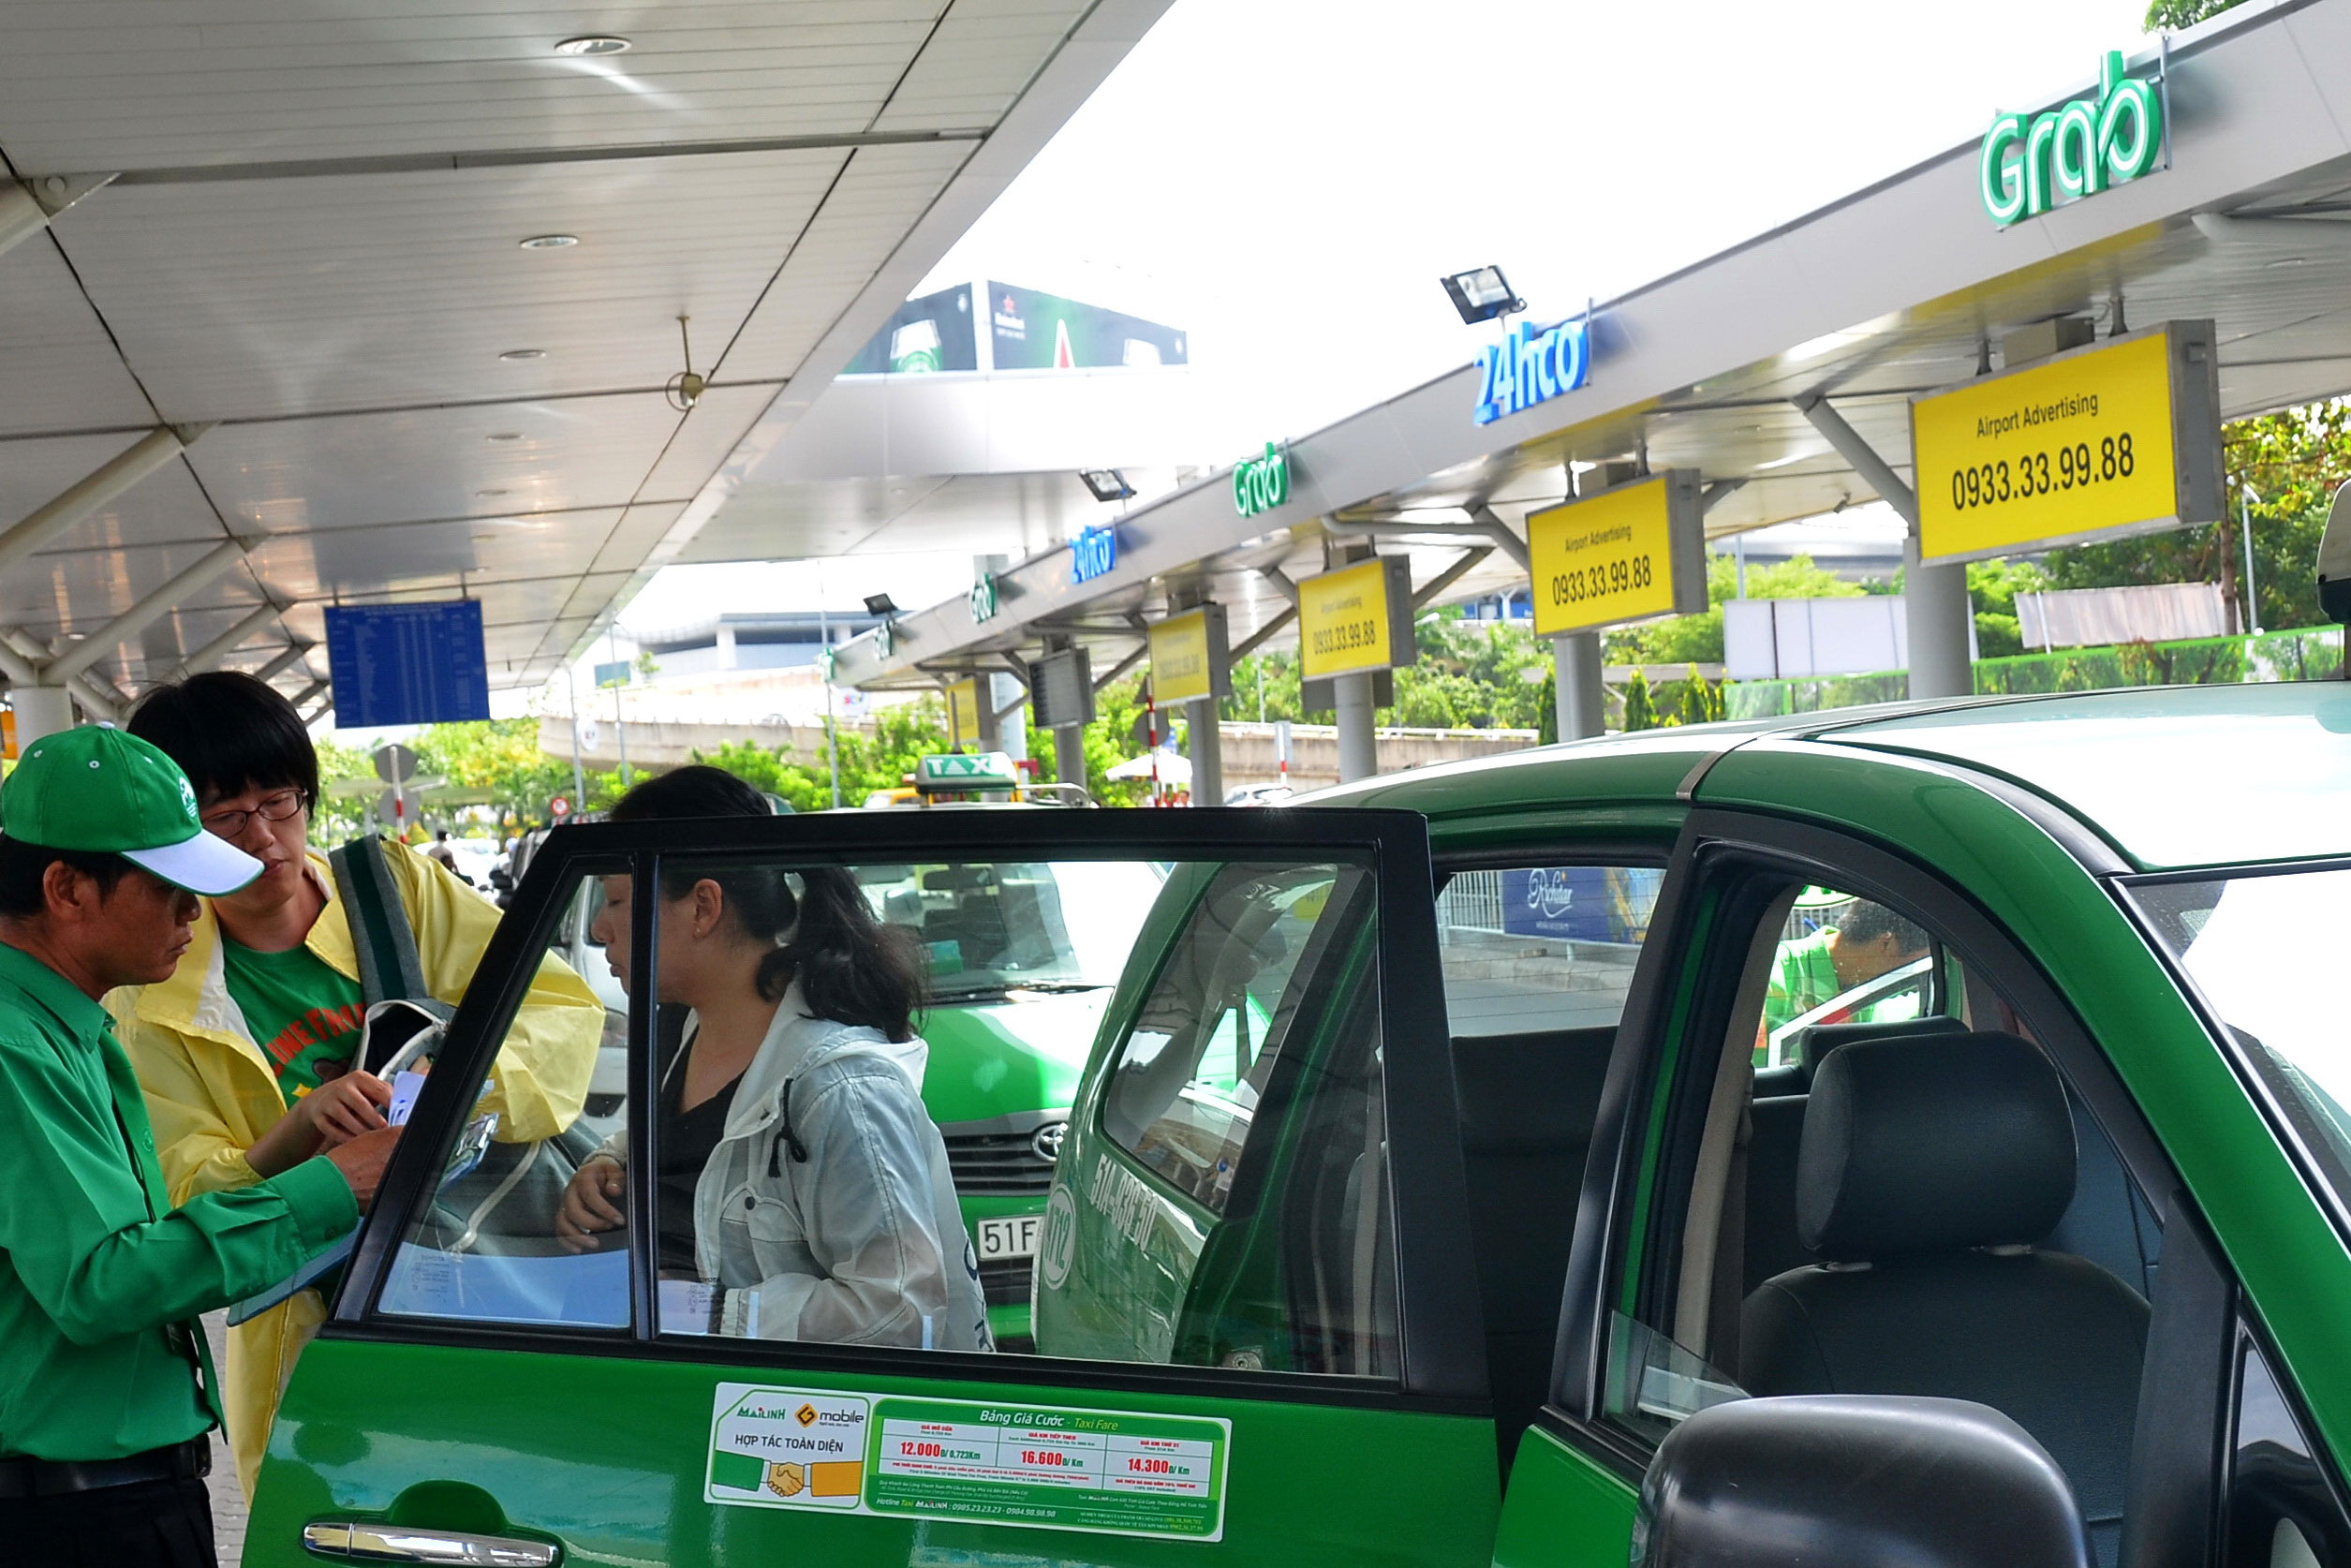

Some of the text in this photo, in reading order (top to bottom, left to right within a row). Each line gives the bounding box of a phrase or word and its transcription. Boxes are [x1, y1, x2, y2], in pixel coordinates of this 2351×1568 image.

[1979, 51, 2161, 225] Grab
[1976, 393, 2099, 438] Airport Advertising
[1233, 441, 1287, 518] Grab
[1952, 432, 2134, 510] 0933.33.99.88
[1552, 555, 1651, 606] 0933.33.99.88
[926, 757, 998, 776] TAX
[734, 1434, 844, 1454] HỢP TÁC TOÀN DIỆN
[980, 1410, 1011, 1425] Bảng
[1013, 1412, 1033, 1424] Giá
[1035, 1413, 1065, 1427] Cước
[1074, 1417, 1094, 1427] Taxi
[1095, 1419, 1118, 1430] Fare
